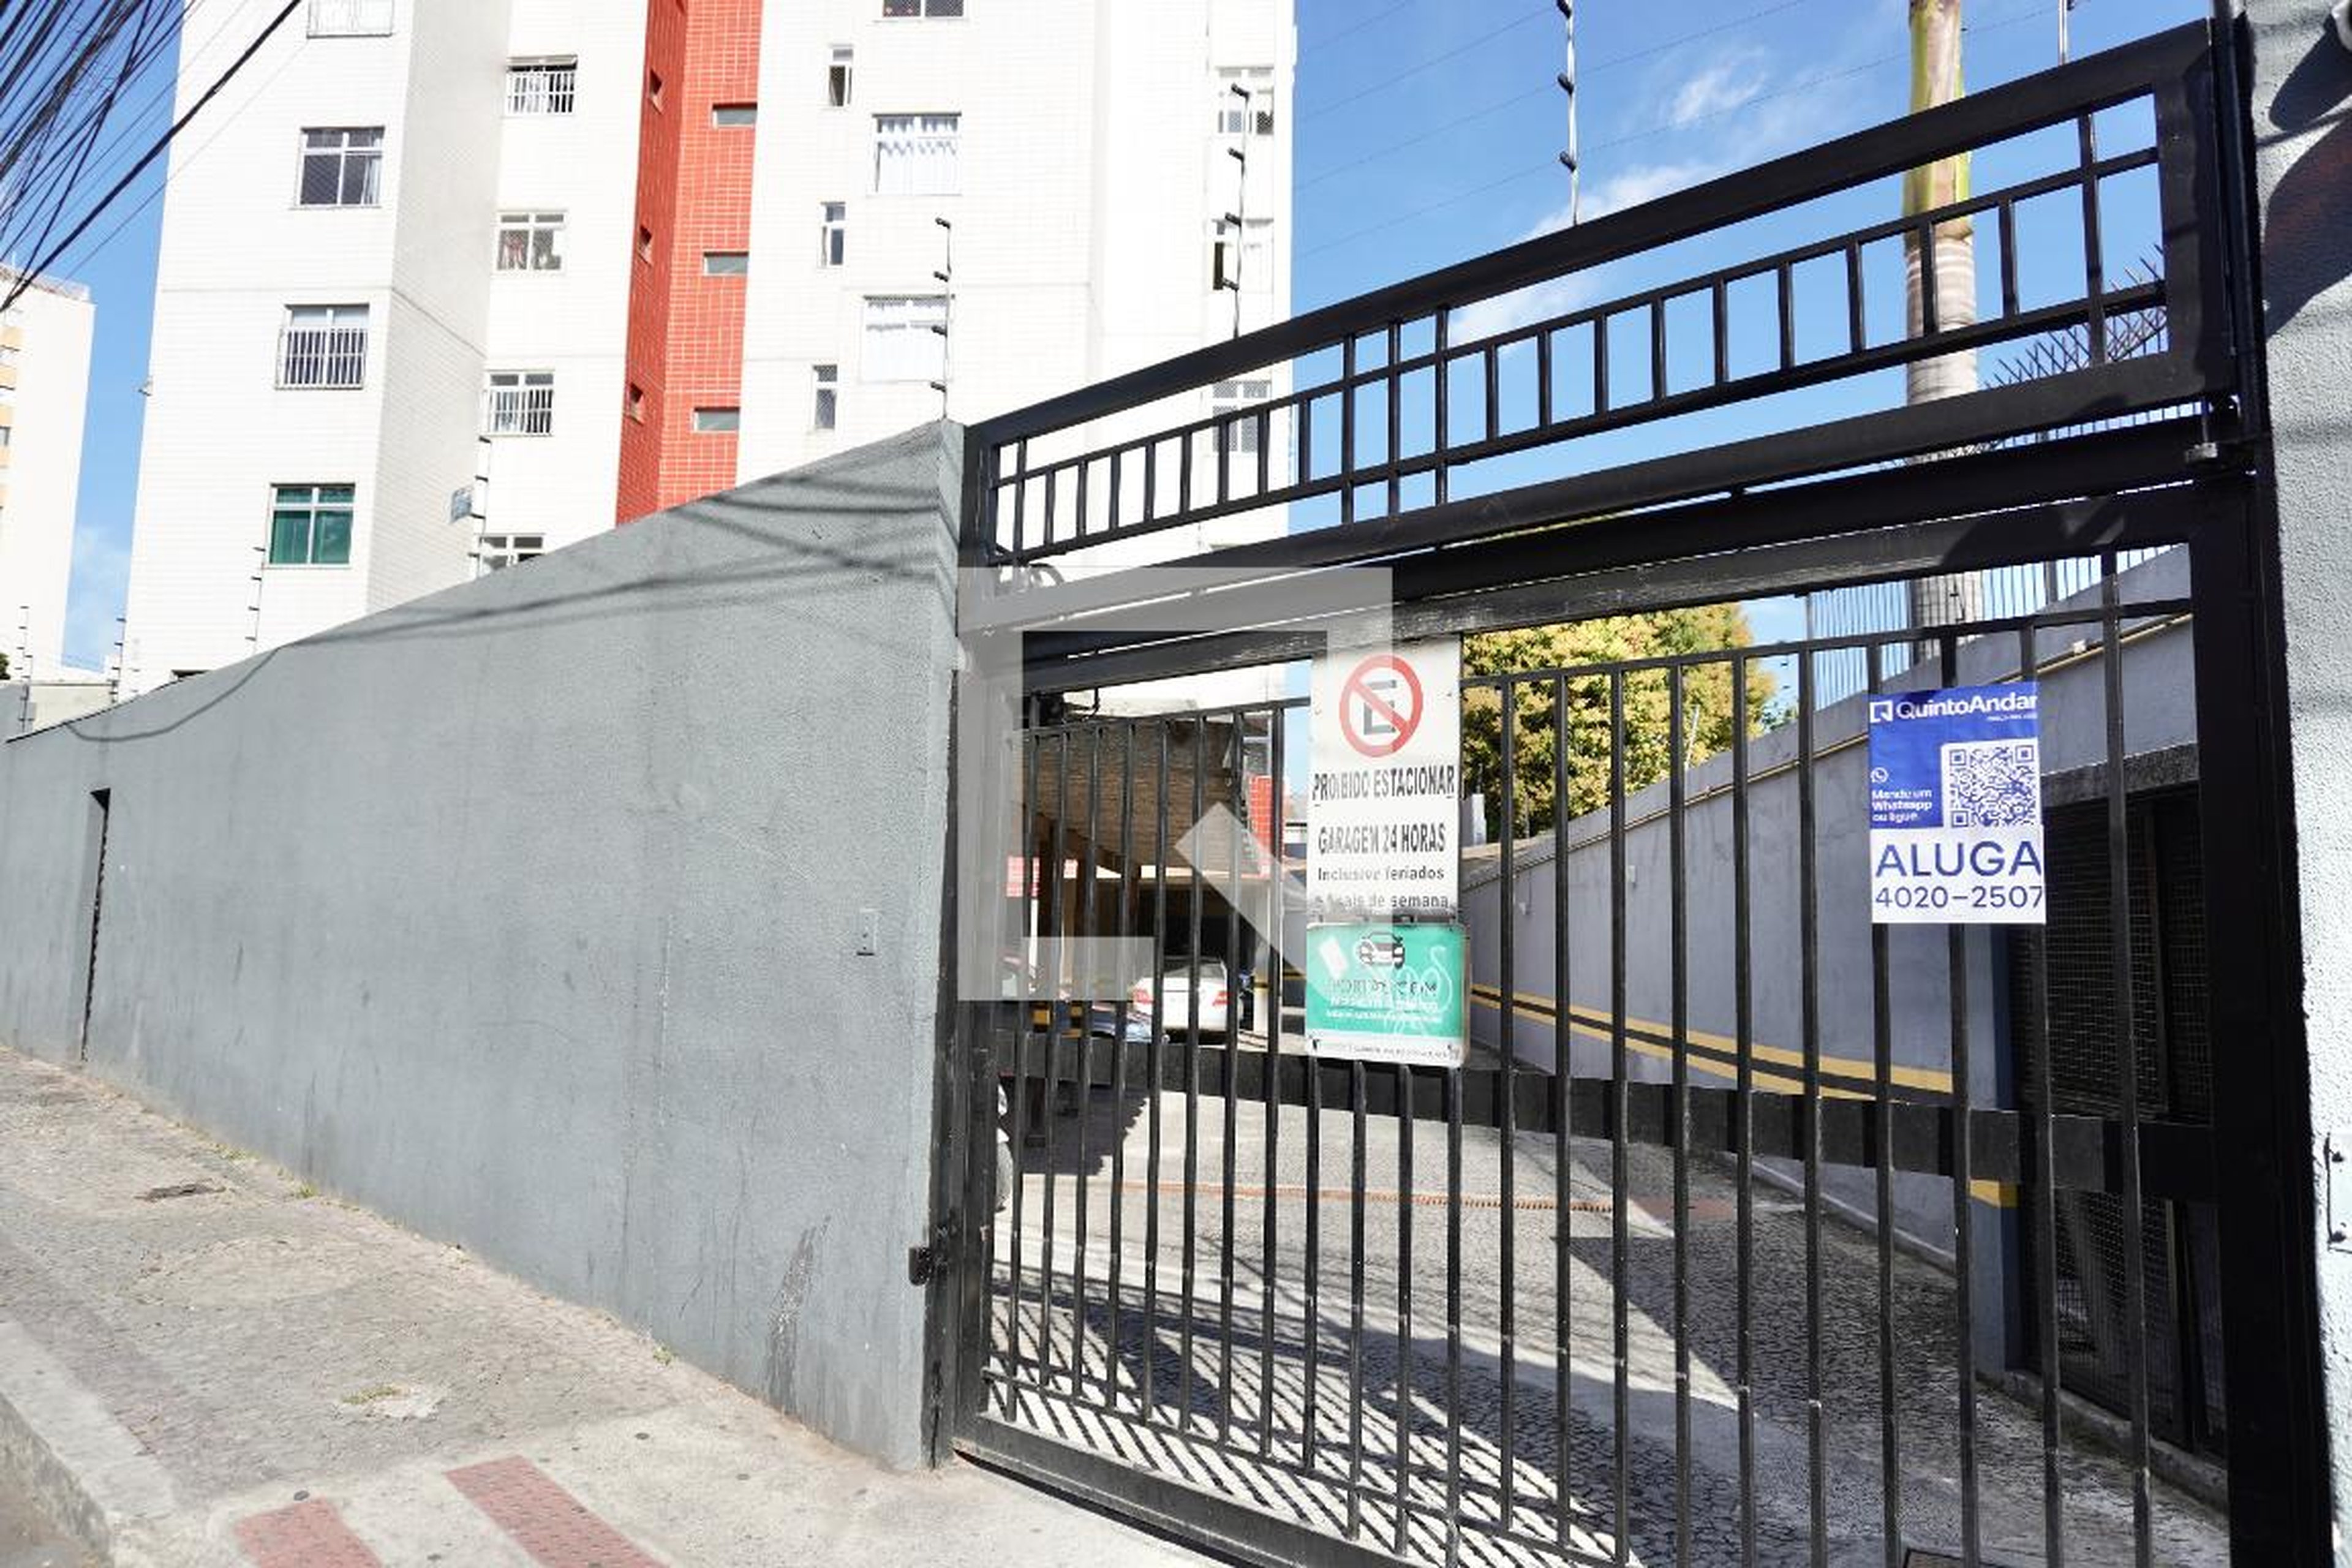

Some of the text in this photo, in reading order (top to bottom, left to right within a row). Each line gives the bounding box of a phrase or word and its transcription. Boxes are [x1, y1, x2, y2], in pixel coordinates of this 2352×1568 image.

[1896, 692, 2038, 720] QuintoAndar
[1312, 765, 1455, 801] PROIBIDO ESTACIONAR
[1318, 823, 1447, 855] GARAGEM 24 HORAS
[1385, 864, 1445, 881] feriados
[1875, 840, 2042, 878] ALUGA
[1390, 895, 1449, 909] semana
[1875, 886, 2043, 908] 4020-2507
